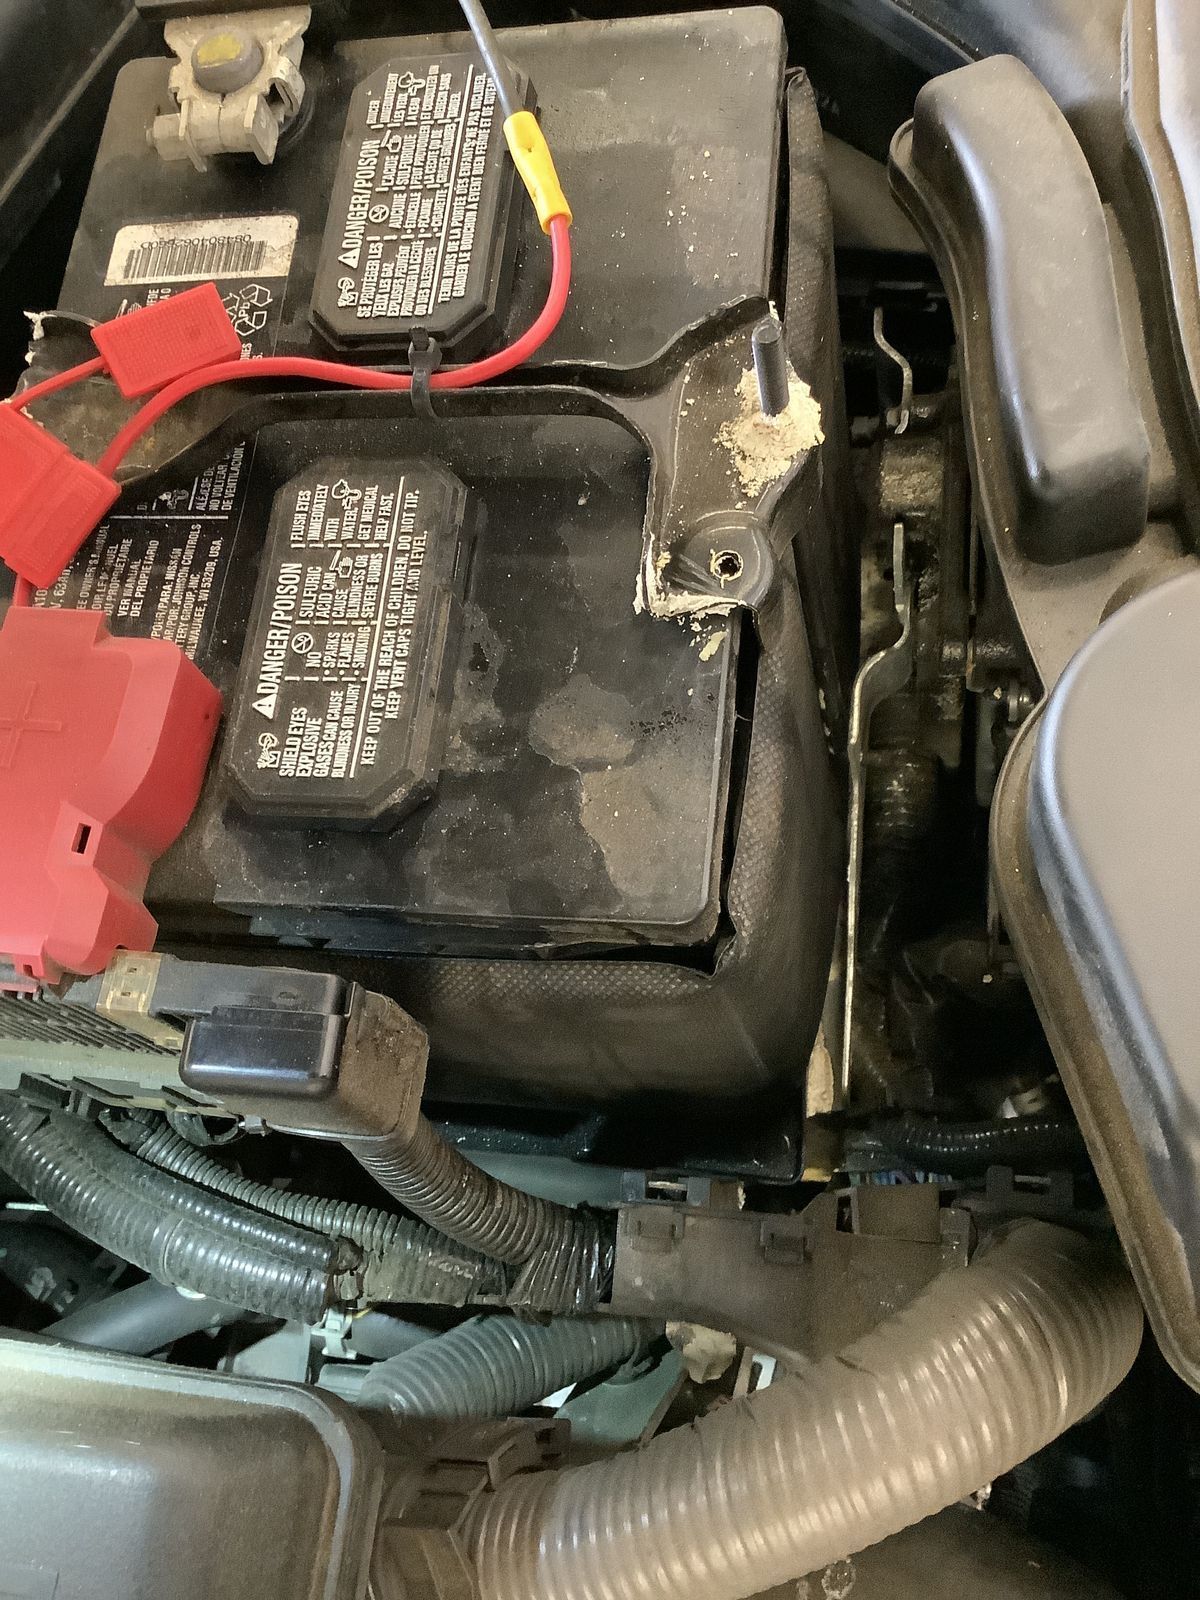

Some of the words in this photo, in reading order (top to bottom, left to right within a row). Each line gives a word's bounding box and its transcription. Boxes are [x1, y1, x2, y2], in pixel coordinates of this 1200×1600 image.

[466, 110, 480, 125] PAS
[479, 118, 491, 127] ET
[481, 105, 493, 116] DE
[395, 134, 416, 184] SULFURIQUE
[471, 155, 485, 175] BIEN
[410, 167, 423, 184] PEUT
[423, 174, 434, 184] LA
[342, 139, 379, 247] DANGER/POISON
[388, 193, 407, 228] AUCUNE
[430, 189, 447, 226] CIGARETTE
[448, 227, 461, 239] LA
[459, 210, 476, 250] BOUCHON
[446, 240, 459, 251] DE
[457, 251, 470, 262] LE
[380, 262, 394, 277] GAZ
[407, 264, 420, 274] LA
[419, 246, 437, 287] BLESSURES
[442, 253, 457, 276] HORS
[356, 305, 372, 317] SE
[367, 242, 383, 258] LES
[378, 278, 391, 292] LES
[437, 277, 453, 302] TENIR
[452, 263, 468, 296] GARDER
[371, 293, 389, 317] YEUX
[386, 278, 405, 316] EXPLOSIFS
[416, 288, 430, 303] DES
[238, 302, 251, 318] Pb
[413, 304, 427, 315] OU
[208, 499, 220, 510] NO
[220, 499, 233, 510] DE
[295, 490, 311, 511] EYES
[307, 484, 328, 540] IMMEDIATELY
[360, 484, 378, 521] MEDICAL
[378, 492, 394, 515] FAST.
[403, 489, 419, 509] TIP.
[290, 513, 306, 540] FLUSH
[323, 517, 339, 540] WITH
[340, 507, 358, 539] WATER.
[357, 523, 371, 540] GET
[373, 517, 389, 540] HELP
[400, 511, 415, 532] NOT
[181, 523, 201, 565] CONTROLS
[396, 535, 411, 550] DO
[409, 530, 427, 565] LEVEL.
[134, 540, 158, 597] PROPIETARIO
[200, 558, 217, 587] 53209,
[354, 554, 368, 567] OR
[366, 552, 383, 582] BURNS
[122, 559, 141, 596] MANUAL
[171, 566, 189, 605] JOHNSON
[321, 572, 336, 590] CAN
[387, 553, 409, 609] CHILDREN.
[405, 568, 420, 590] AND
[76, 599, 87, 609] EE
[91, 594, 104, 609] OIR
[150, 581, 173, 641] /POUR/PARA:
[164, 548, 182, 579] NISSAN
[180, 589, 197, 620] GROUP,
[197, 589, 209, 601] WI
[299, 566, 322, 617] SULFURIC
[315, 592, 332, 618] ACID
[331, 588, 348, 617] CAUSE
[345, 569, 365, 617] BLINDNESS
[360, 584, 378, 617] SEVERE
[117, 598, 130, 616] VER
[129, 599, 143, 616] DEL
[384, 612, 399, 626] OF
[399, 593, 417, 625] TIGHT
[163, 606, 180, 641] AR/POR:
[257, 563, 301, 693] DANGER/POISON
[322, 632, 340, 667] SPARKS
[336, 632, 355, 667] FLAMES
[351, 626, 370, 667] SMOKING
[378, 630, 396, 666] REACH
[394, 628, 411, 656] CAPS
[305, 651, 321, 667] NO
[373, 669, 390, 690] THE
[389, 659, 407, 688] VENT
[326, 690, 343, 720] CAUSE
[343, 683, 360, 714] INJURY
[370, 693, 385, 707] OF
[384, 690, 401, 718] KEEP
[287, 707, 307, 734] EYES
[322, 721, 338, 740] CAN
[340, 715, 355, 728] OR
[366, 710, 382, 733] OUT
[278, 737, 301, 776] SHIELD
[295, 717, 322, 776] EXPLOSIVE
[312, 741, 334, 776] GASES
[331, 729, 352, 777] BLINDNESS
[360, 736, 377, 764] KEEP
